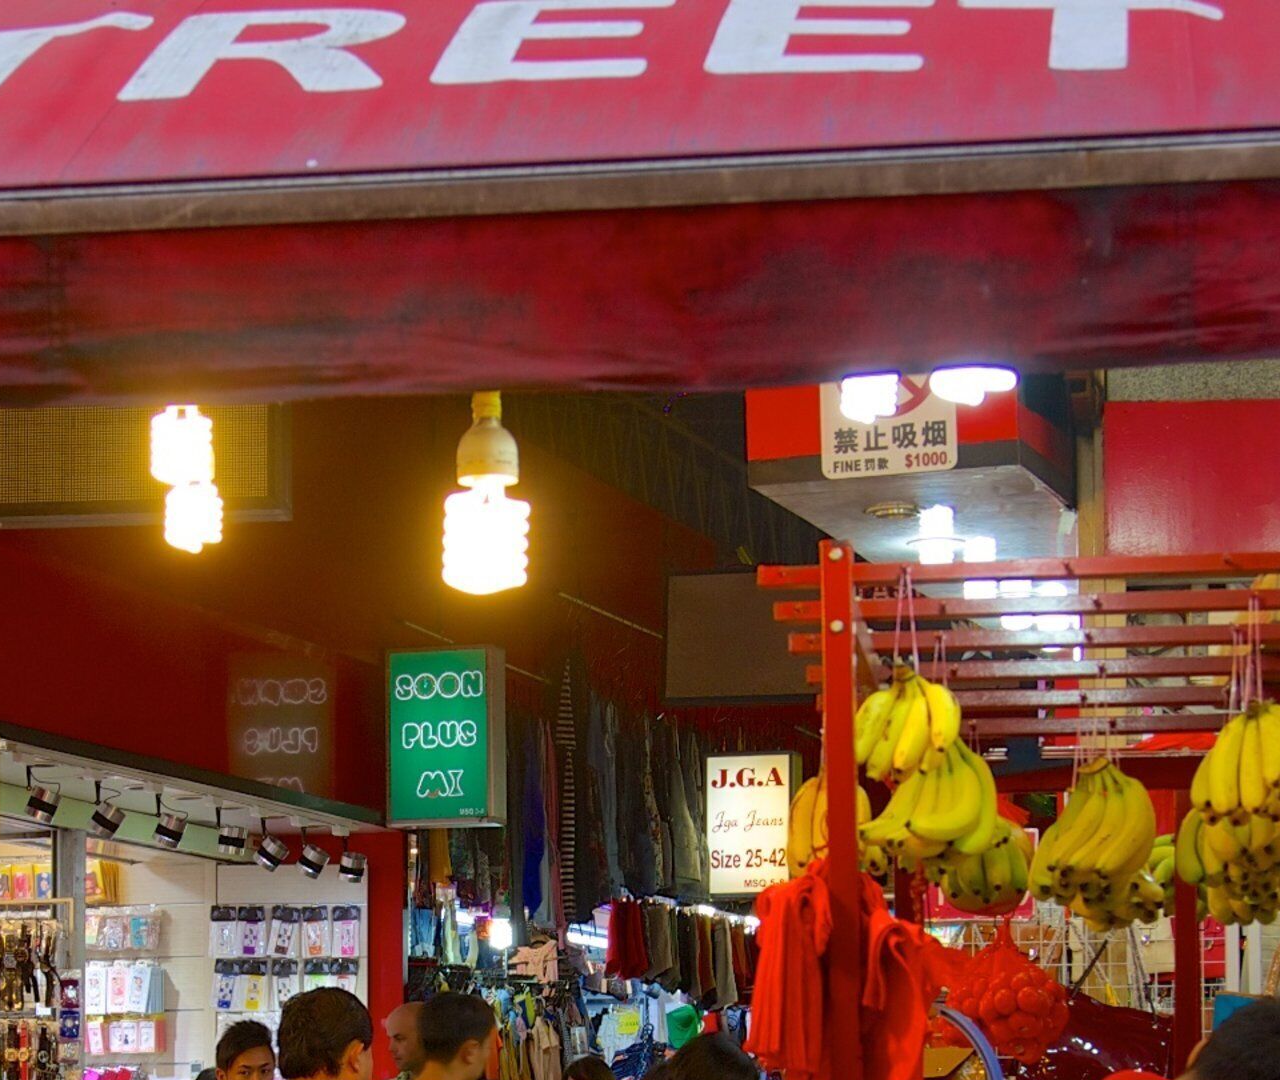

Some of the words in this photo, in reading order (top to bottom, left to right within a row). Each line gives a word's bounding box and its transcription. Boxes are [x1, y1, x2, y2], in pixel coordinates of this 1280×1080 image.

[833, 420, 948, 454] 禁止吸烟
[833, 460, 862, 474] FINE
[864, 457, 889, 471] 罚款
[904, 451, 948, 469] $1000
[395, 670, 483, 700] SOON
[402, 720, 478, 749] PLUS
[416, 769, 464, 798] MI
[711, 767, 785, 789] J.G.A
[711, 811, 739, 834] Jga
[743, 810, 784, 833] Jeans
[711, 849, 741, 869] Size
[745, 848, 786, 868] 25-42
[743, 879, 767, 888] MSQ
